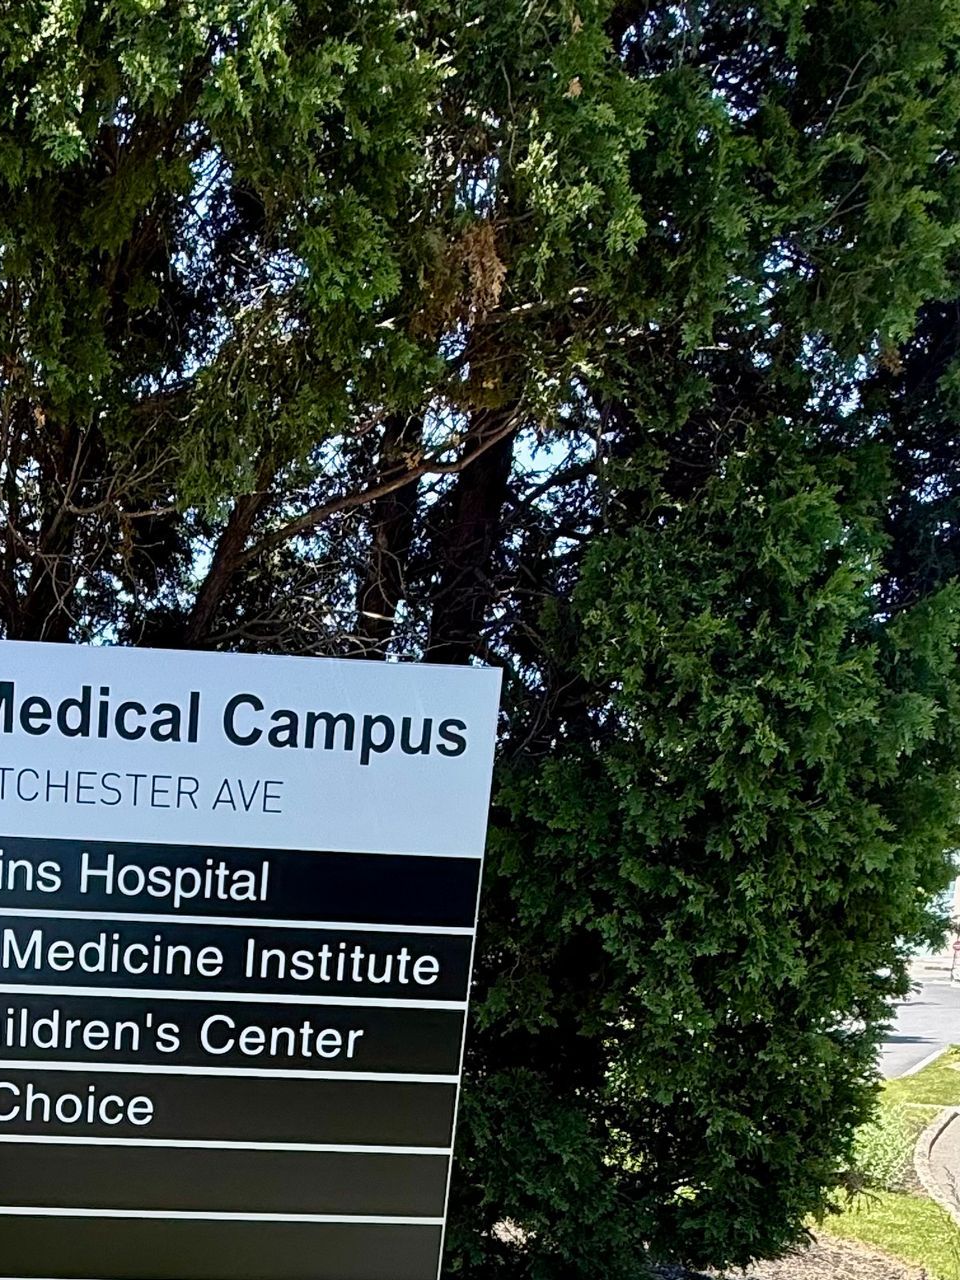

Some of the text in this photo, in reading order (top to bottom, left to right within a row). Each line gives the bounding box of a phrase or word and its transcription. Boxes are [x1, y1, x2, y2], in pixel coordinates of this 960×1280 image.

[223, 693, 467, 766] Campus
[211, 778, 284, 814] AVE
[80, 852, 269, 909] Hospital
[2, 928, 224, 977] Medicine
[245, 938, 440, 985] Institute
[200, 1014, 364, 1058] Center
